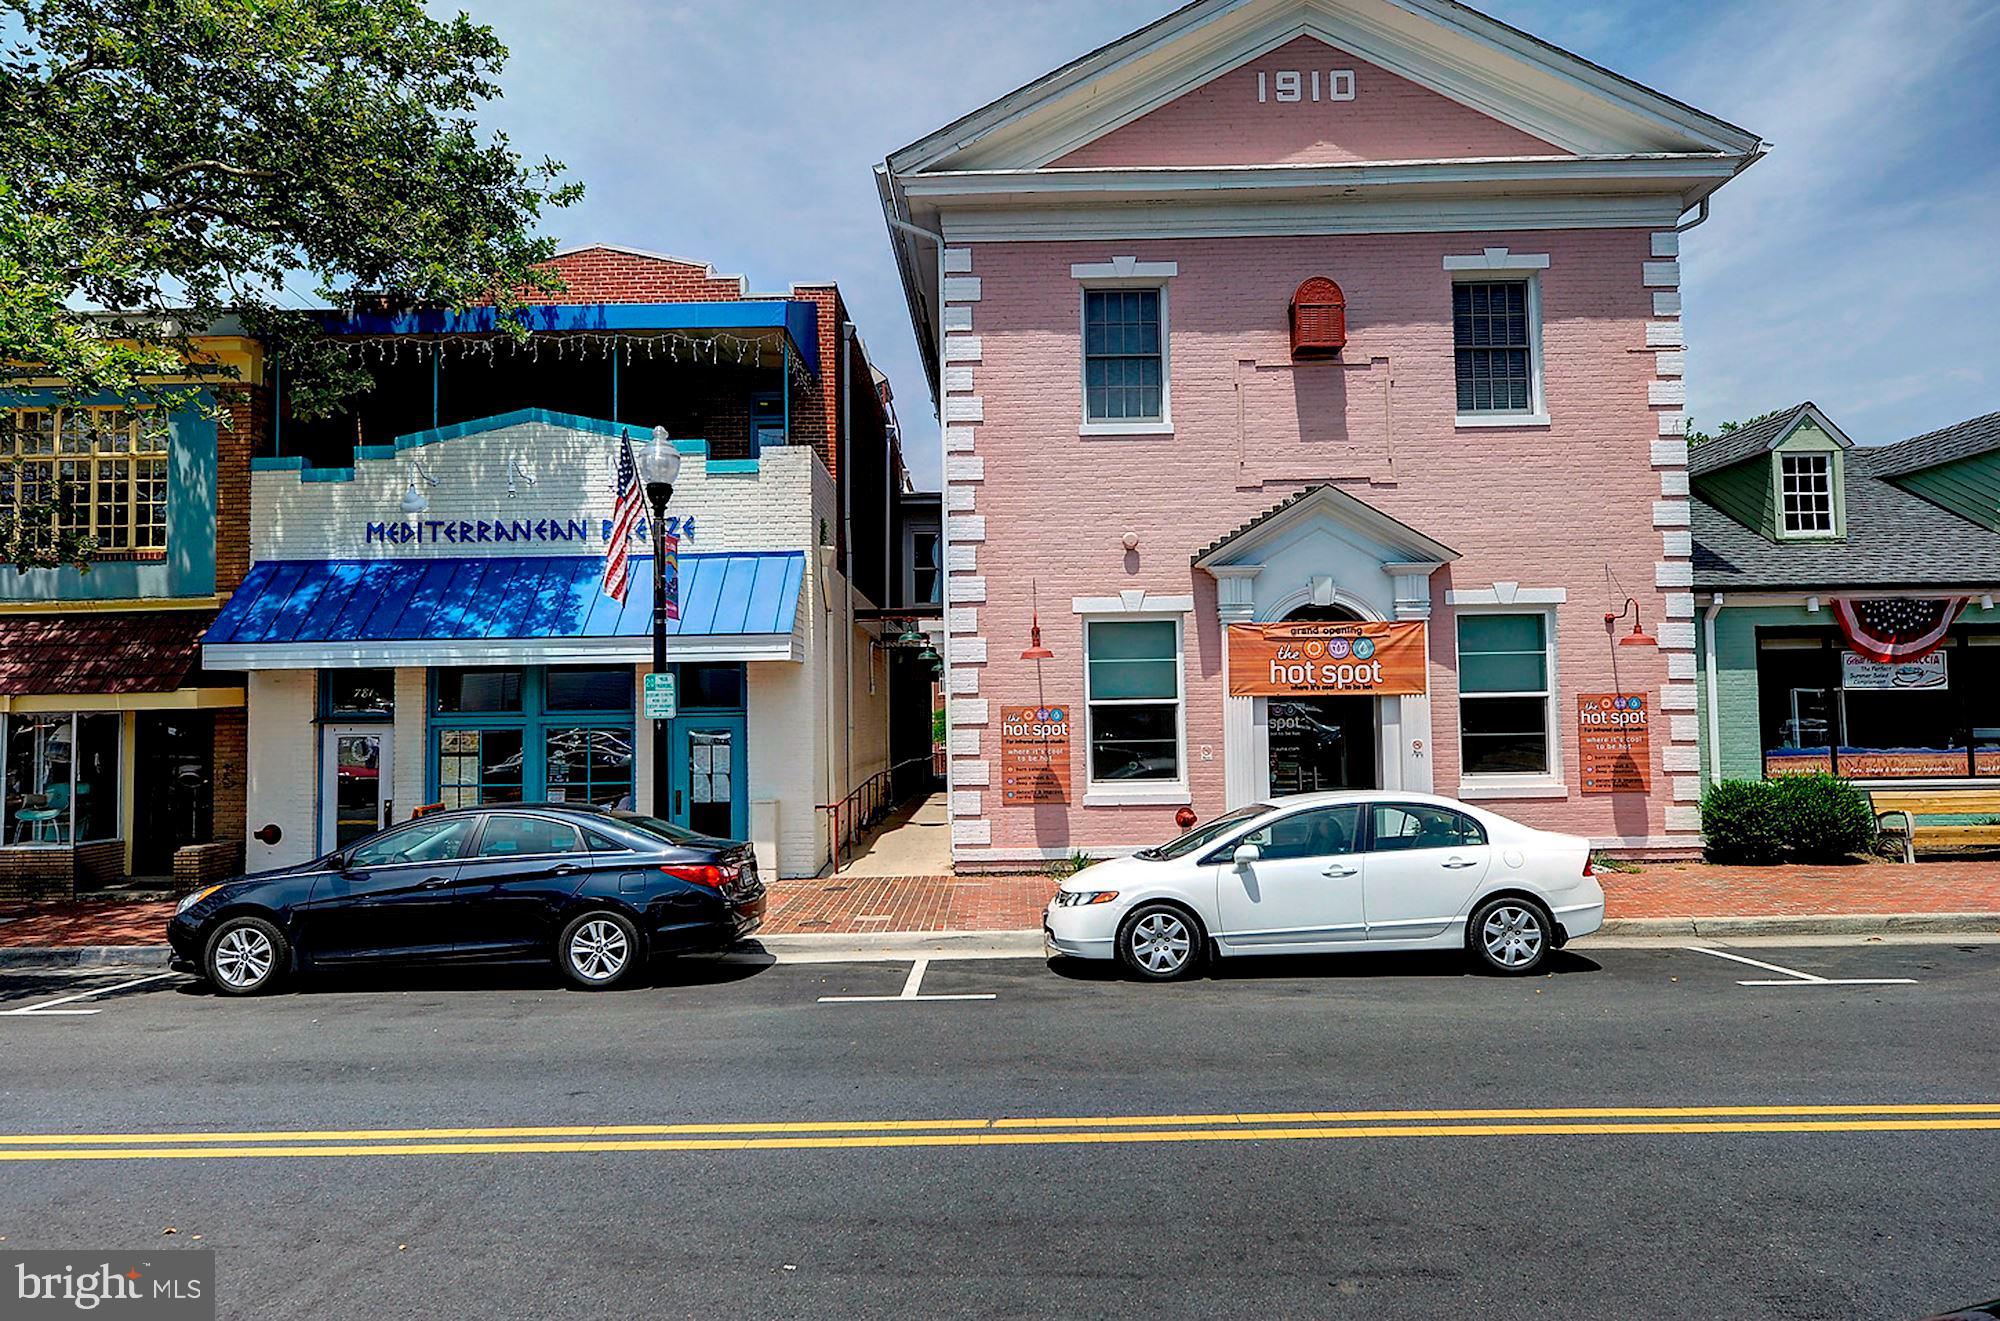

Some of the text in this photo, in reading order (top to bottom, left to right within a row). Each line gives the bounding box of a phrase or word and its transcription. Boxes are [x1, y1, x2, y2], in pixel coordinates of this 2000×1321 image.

[1258, 70, 1356, 102] 1910
[366, 516, 695, 544] MEDITERRANEAN BEZE
[1290, 625, 1363, 637] grand opening
[1276, 644, 1300, 660] the
[1269, 659, 1384, 690] hot spot
[1585, 701, 1599, 711] the
[1007, 713, 1020, 722] the
[1268, 716, 1300, 731] spot
[1581, 710, 1647, 728] hot spot
[1003, 722, 1068, 739] hot spot
